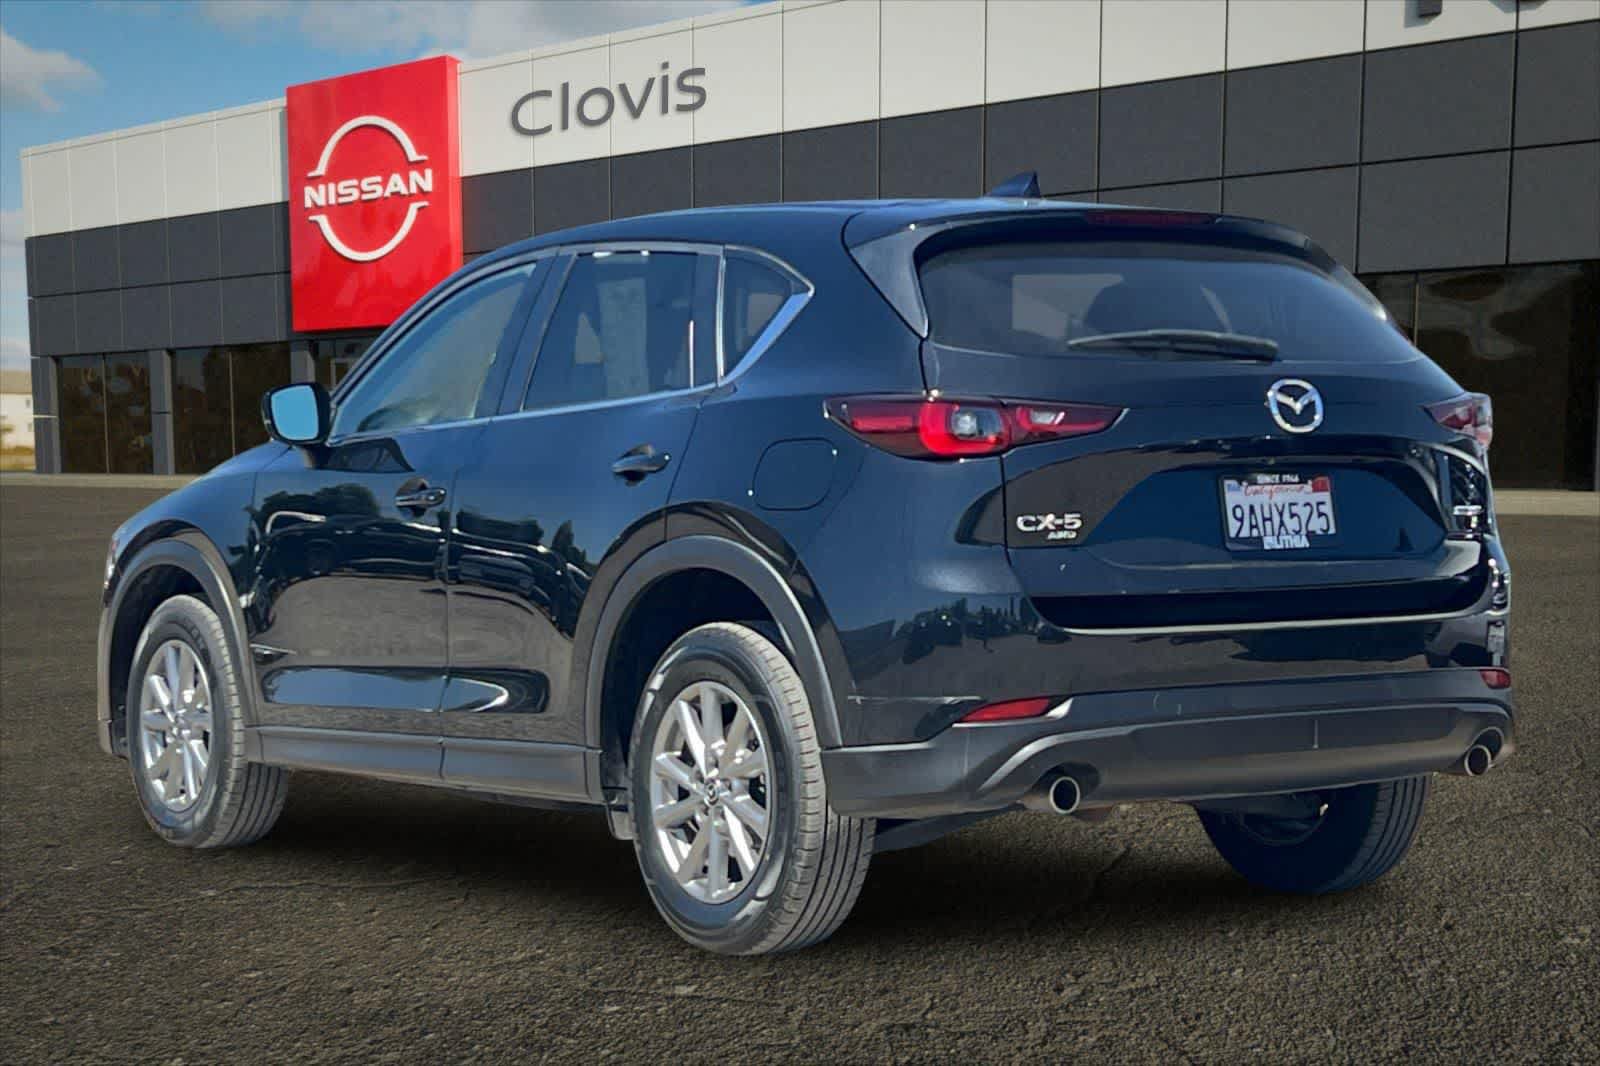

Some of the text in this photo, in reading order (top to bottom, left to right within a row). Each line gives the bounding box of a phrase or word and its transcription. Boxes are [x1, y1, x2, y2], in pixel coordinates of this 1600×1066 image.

[511, 62, 707, 136] Clovis
[303, 169, 433, 209] NISSAN
[1016, 512, 1083, 532] CX-5
[1232, 501, 1330, 538] 9AHX525
